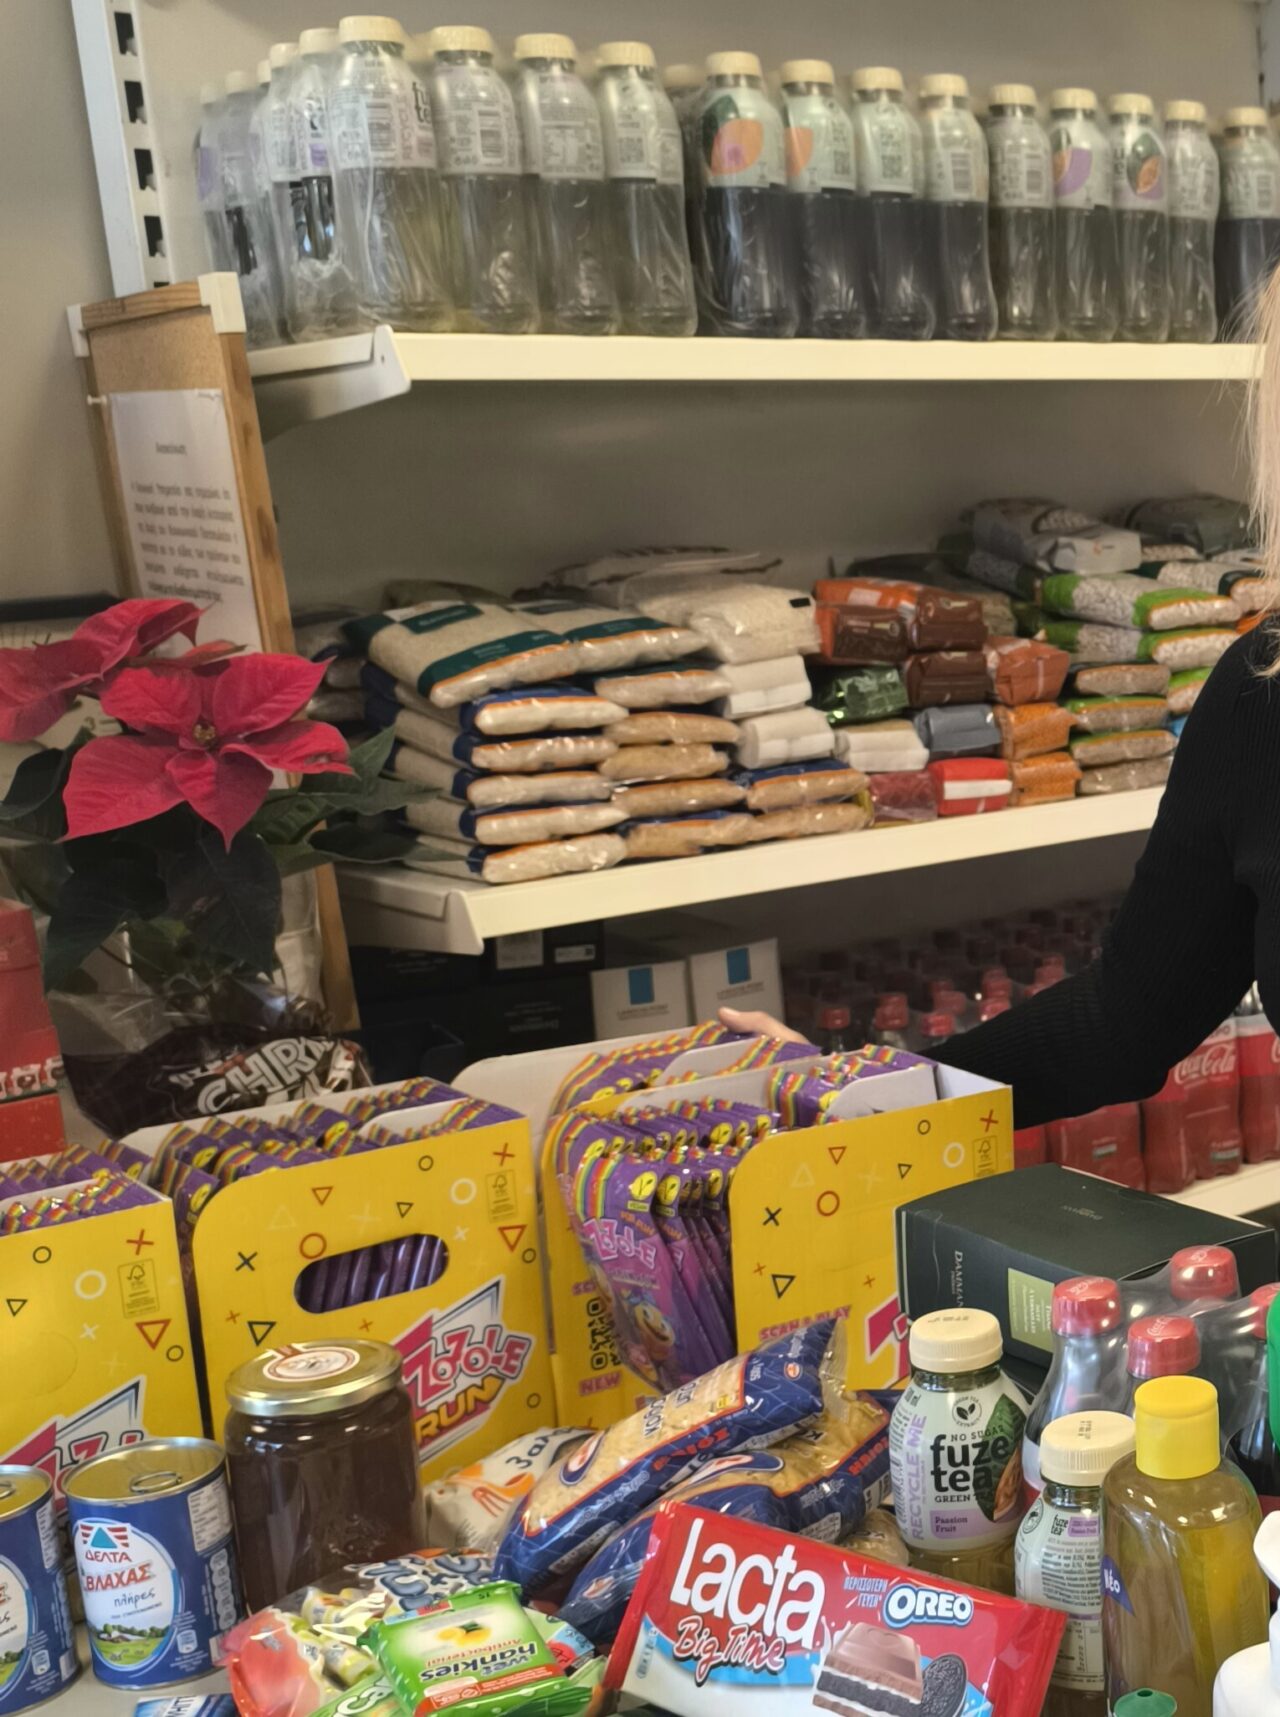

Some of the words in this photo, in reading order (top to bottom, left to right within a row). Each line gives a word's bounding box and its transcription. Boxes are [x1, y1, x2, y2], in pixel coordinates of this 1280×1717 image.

[415, 1374, 506, 1446] RUN
[906, 1414, 927, 1449] ME
[950, 1433, 967, 1442] NO
[930, 1434, 1009, 1468] fuze
[930, 1464, 994, 1493] tea
[906, 1453, 925, 1541] RECYCLE
[934, 1494, 971, 1503] GREEN
[935, 1516, 968, 1524] Passion
[935, 1525, 957, 1533] Fruit
[86, 1563, 152, 1592] ΒΛΑΧΑΣ
[669, 1518, 826, 1650] Lacta
[1104, 1568, 1121, 1594] Νέο
[887, 1585, 972, 1621] OREO
[420, 1641, 538, 1682] hankies
[427, 1638, 522, 1668] Antibacterial
[480, 1656, 530, 1676] wet
[673, 1615, 720, 1687] Big
[722, 1624, 788, 1671] Time
